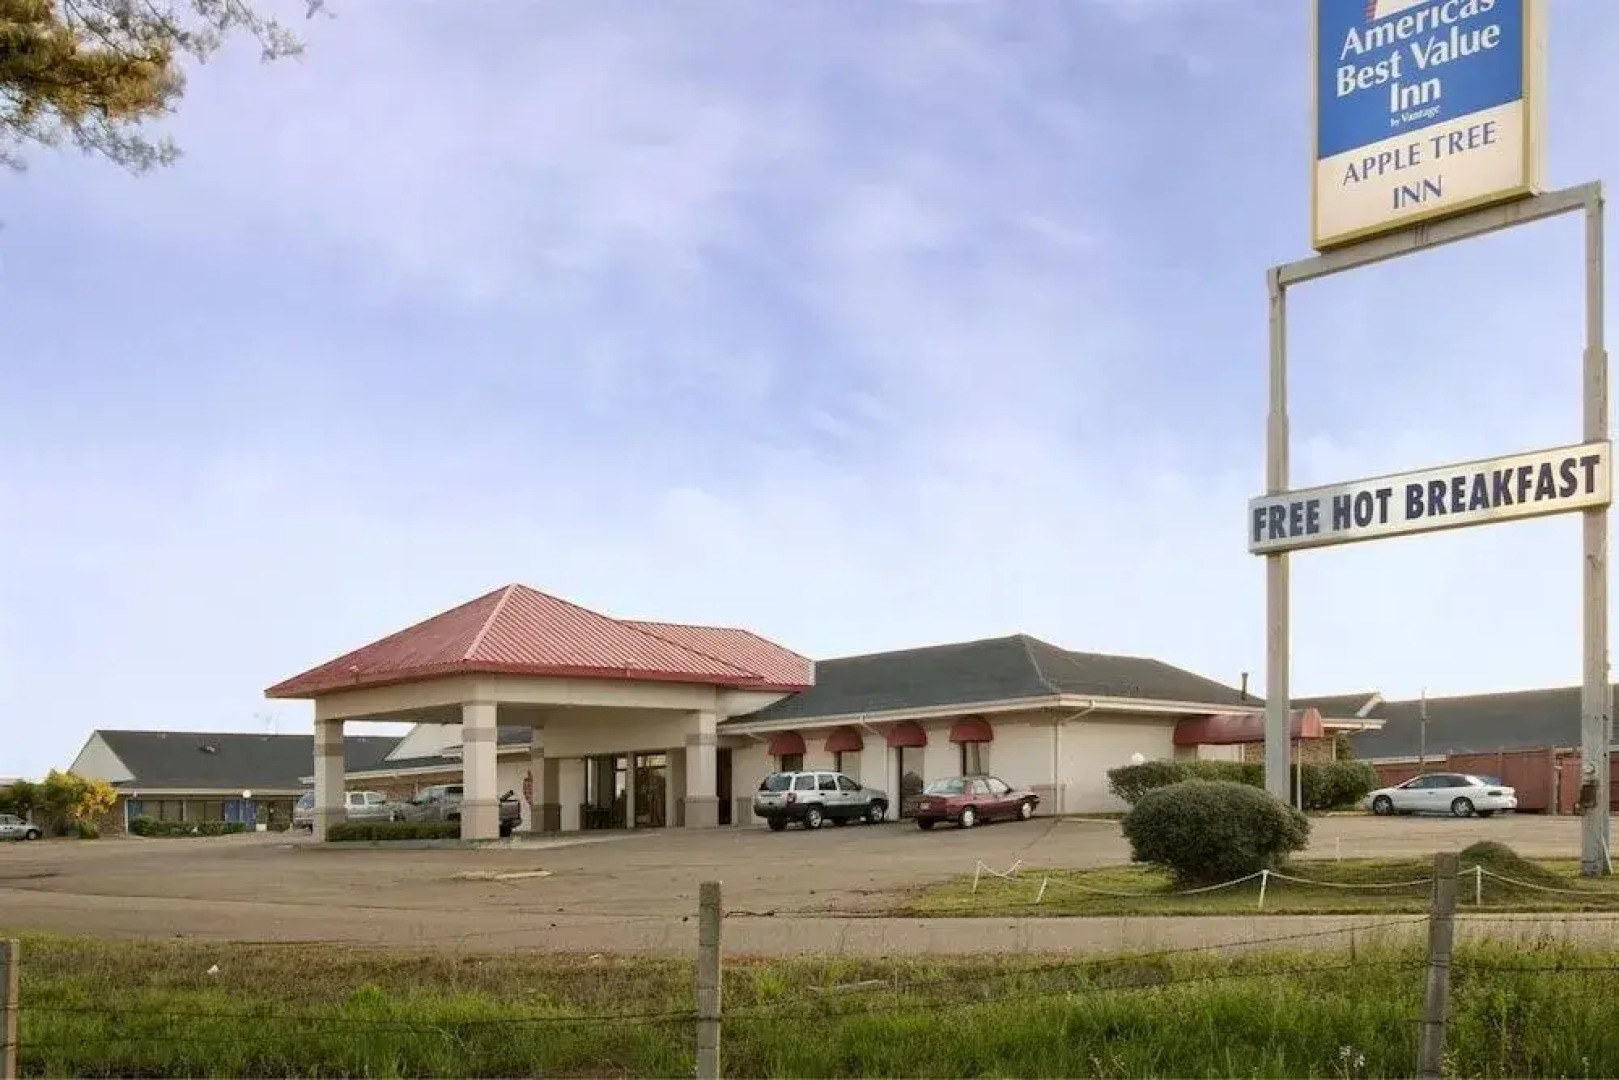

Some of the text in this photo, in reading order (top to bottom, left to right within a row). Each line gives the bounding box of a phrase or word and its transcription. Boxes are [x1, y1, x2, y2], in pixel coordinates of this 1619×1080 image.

[1337, 24, 1500, 97] Best Value
[1340, 0, 1495, 60] Americas
[1390, 77, 1441, 113] Inn
[1343, 121, 1496, 186] APPLE TREE
[1393, 175, 1442, 210] INN
[1253, 454, 1600, 542] FREE HOT BREAKFAST
